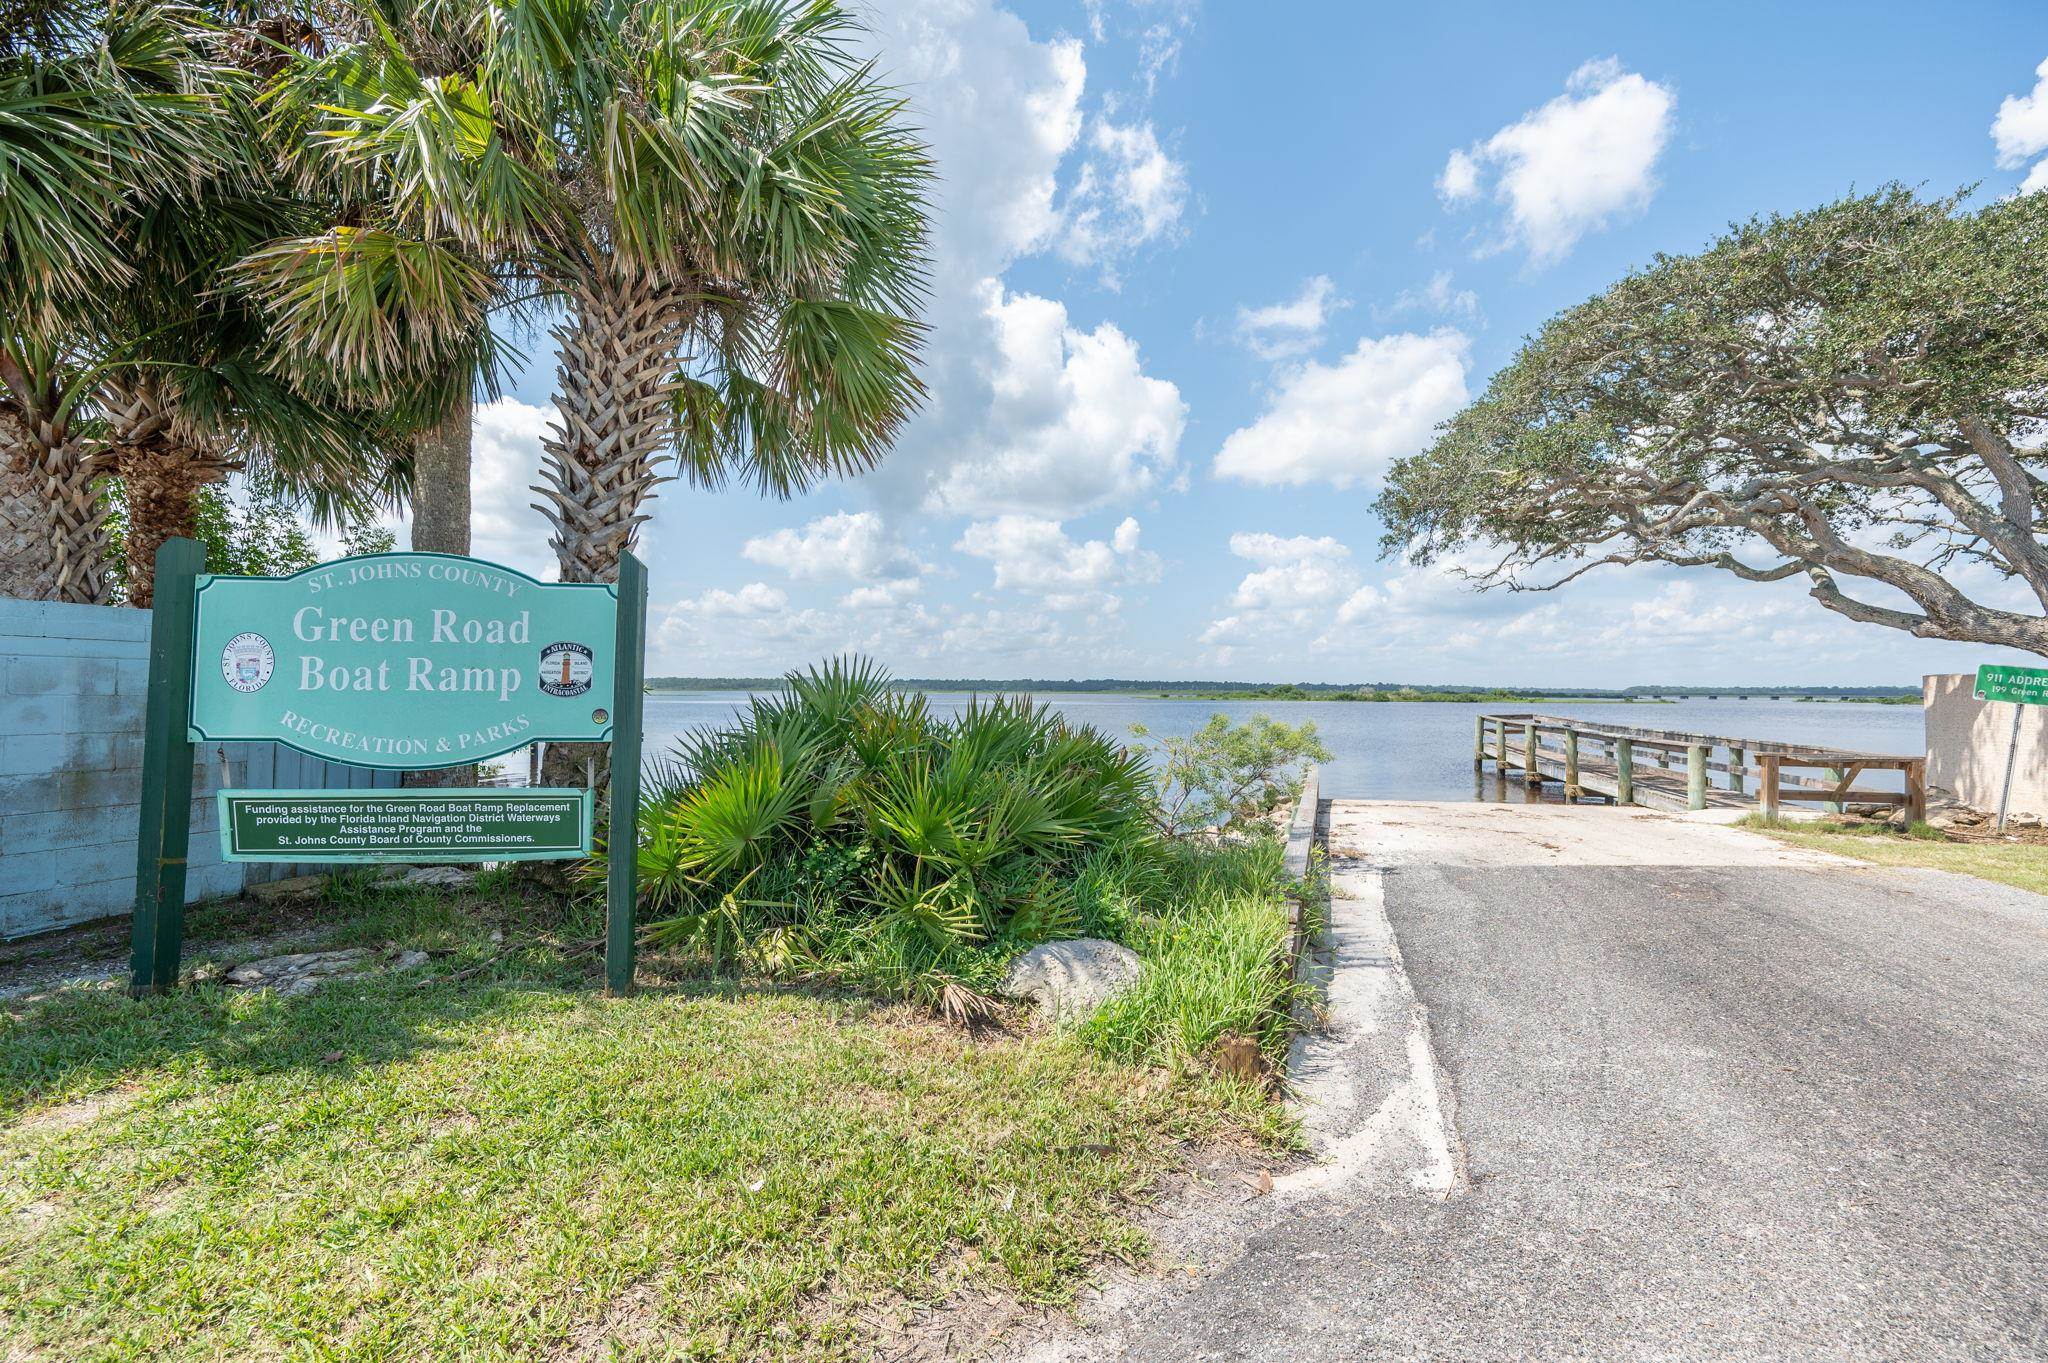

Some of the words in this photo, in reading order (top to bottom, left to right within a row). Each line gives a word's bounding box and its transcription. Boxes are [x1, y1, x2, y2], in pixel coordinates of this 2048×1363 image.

[308, 572, 343, 594] ST.
[348, 563, 422, 585] JOHNS
[428, 564, 522, 598] COUNTY
[293, 606, 415, 642] Green
[429, 609, 530, 644] Road
[227, 634, 252, 653] JOHNS
[255, 635, 273, 665] COUNTY
[550, 643, 583, 652] ATLANTIC
[298, 656, 391, 692] Boat
[405, 657, 521, 702] Ramp
[1987, 673, 2002, 682] 911
[229, 678, 267, 692] FLORIDA
[543, 684, 588, 696] INTRACOASTAL
[2012, 688, 2038, 696] Green
[280, 710, 428, 755] RECREATION
[435, 737, 452, 753] &
[458, 713, 531, 749] PARKS
[245, 805, 288, 815] Funding
[291, 805, 347, 813] assistance
[349, 805, 364, 813] for
[367, 804, 383, 813] the
[386, 804, 416, 813] Green
[419, 804, 445, 813] Road
[448, 804, 472, 812] Boat
[474, 803, 503, 813] Ramp
[506, 803, 570, 813] Replacement
[256, 816, 302, 826] provided
[304, 816, 318, 825] by
[320, 815, 337, 824] the
[340, 815, 376, 824] Florida
[378, 814, 410, 823] Inland
[412, 814, 466, 824] Navigation
[469, 814, 505, 822] District
[507, 813, 561, 823] Waterways
[340, 825, 396, 834] Assistance
[398, 825, 442, 836] Program
[445, 824, 464, 833] and
[466, 824, 482, 832] the
[278, 836, 292, 845] St.
[294, 836, 327, 845] Johns
[330, 836, 367, 846] County
[369, 835, 401, 844] Board
[403, 835, 413, 844] of
[416, 835, 452, 845] County
[455, 834, 535, 844] Commissioners.
